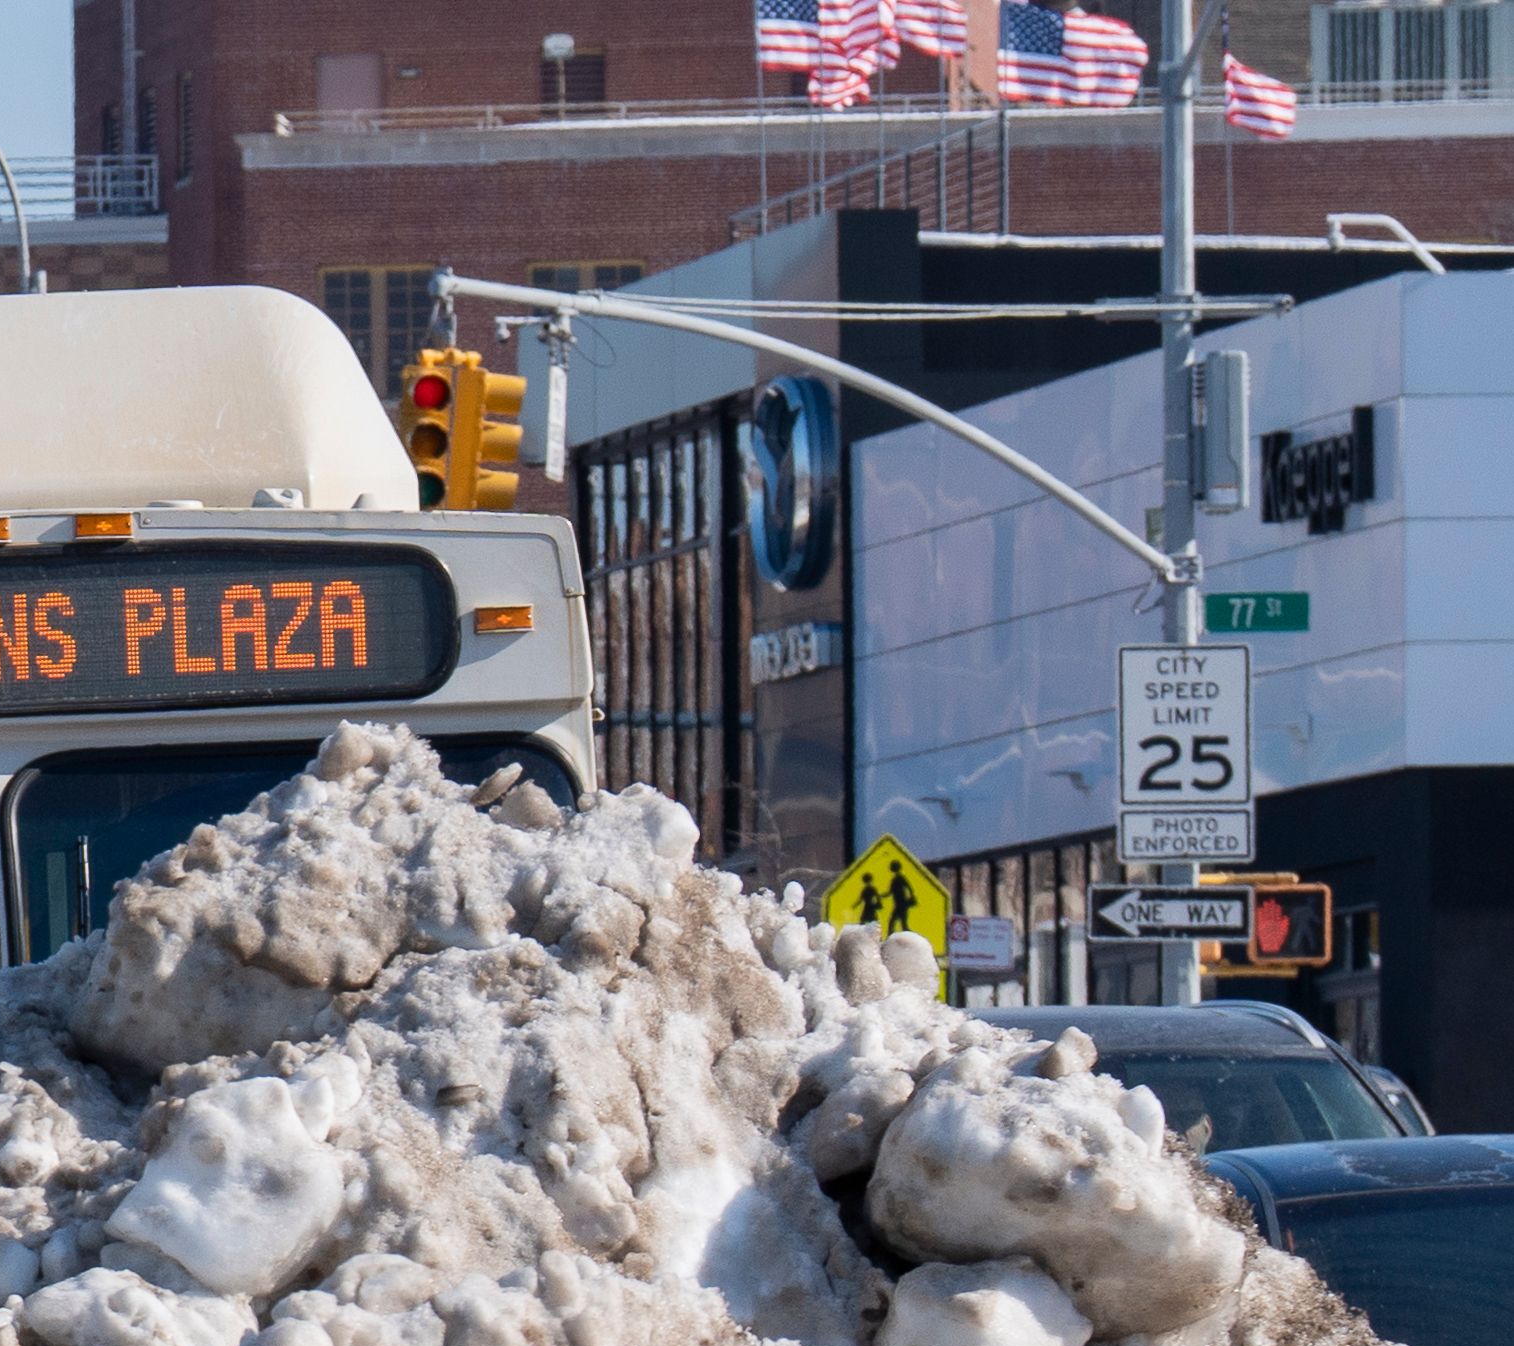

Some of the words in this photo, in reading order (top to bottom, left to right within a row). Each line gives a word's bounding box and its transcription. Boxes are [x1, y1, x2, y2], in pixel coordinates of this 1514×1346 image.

[1260, 404, 1373, 535] Koeppel
[1228, 597, 1256, 629] 77
[123, 579, 369, 677] PLAZA
[1156, 656, 1209, 676] CITY
[1144, 681, 1220, 701] SPEED
[1153, 706, 1213, 725] LIMIT
[1138, 734, 1234, 792] 25
[1151, 817, 1219, 833] PHOTO
[1131, 835, 1240, 852] ENFORCED
[1120, 902, 1164, 923] ONE
[1187, 903, 1234, 923] WAY
